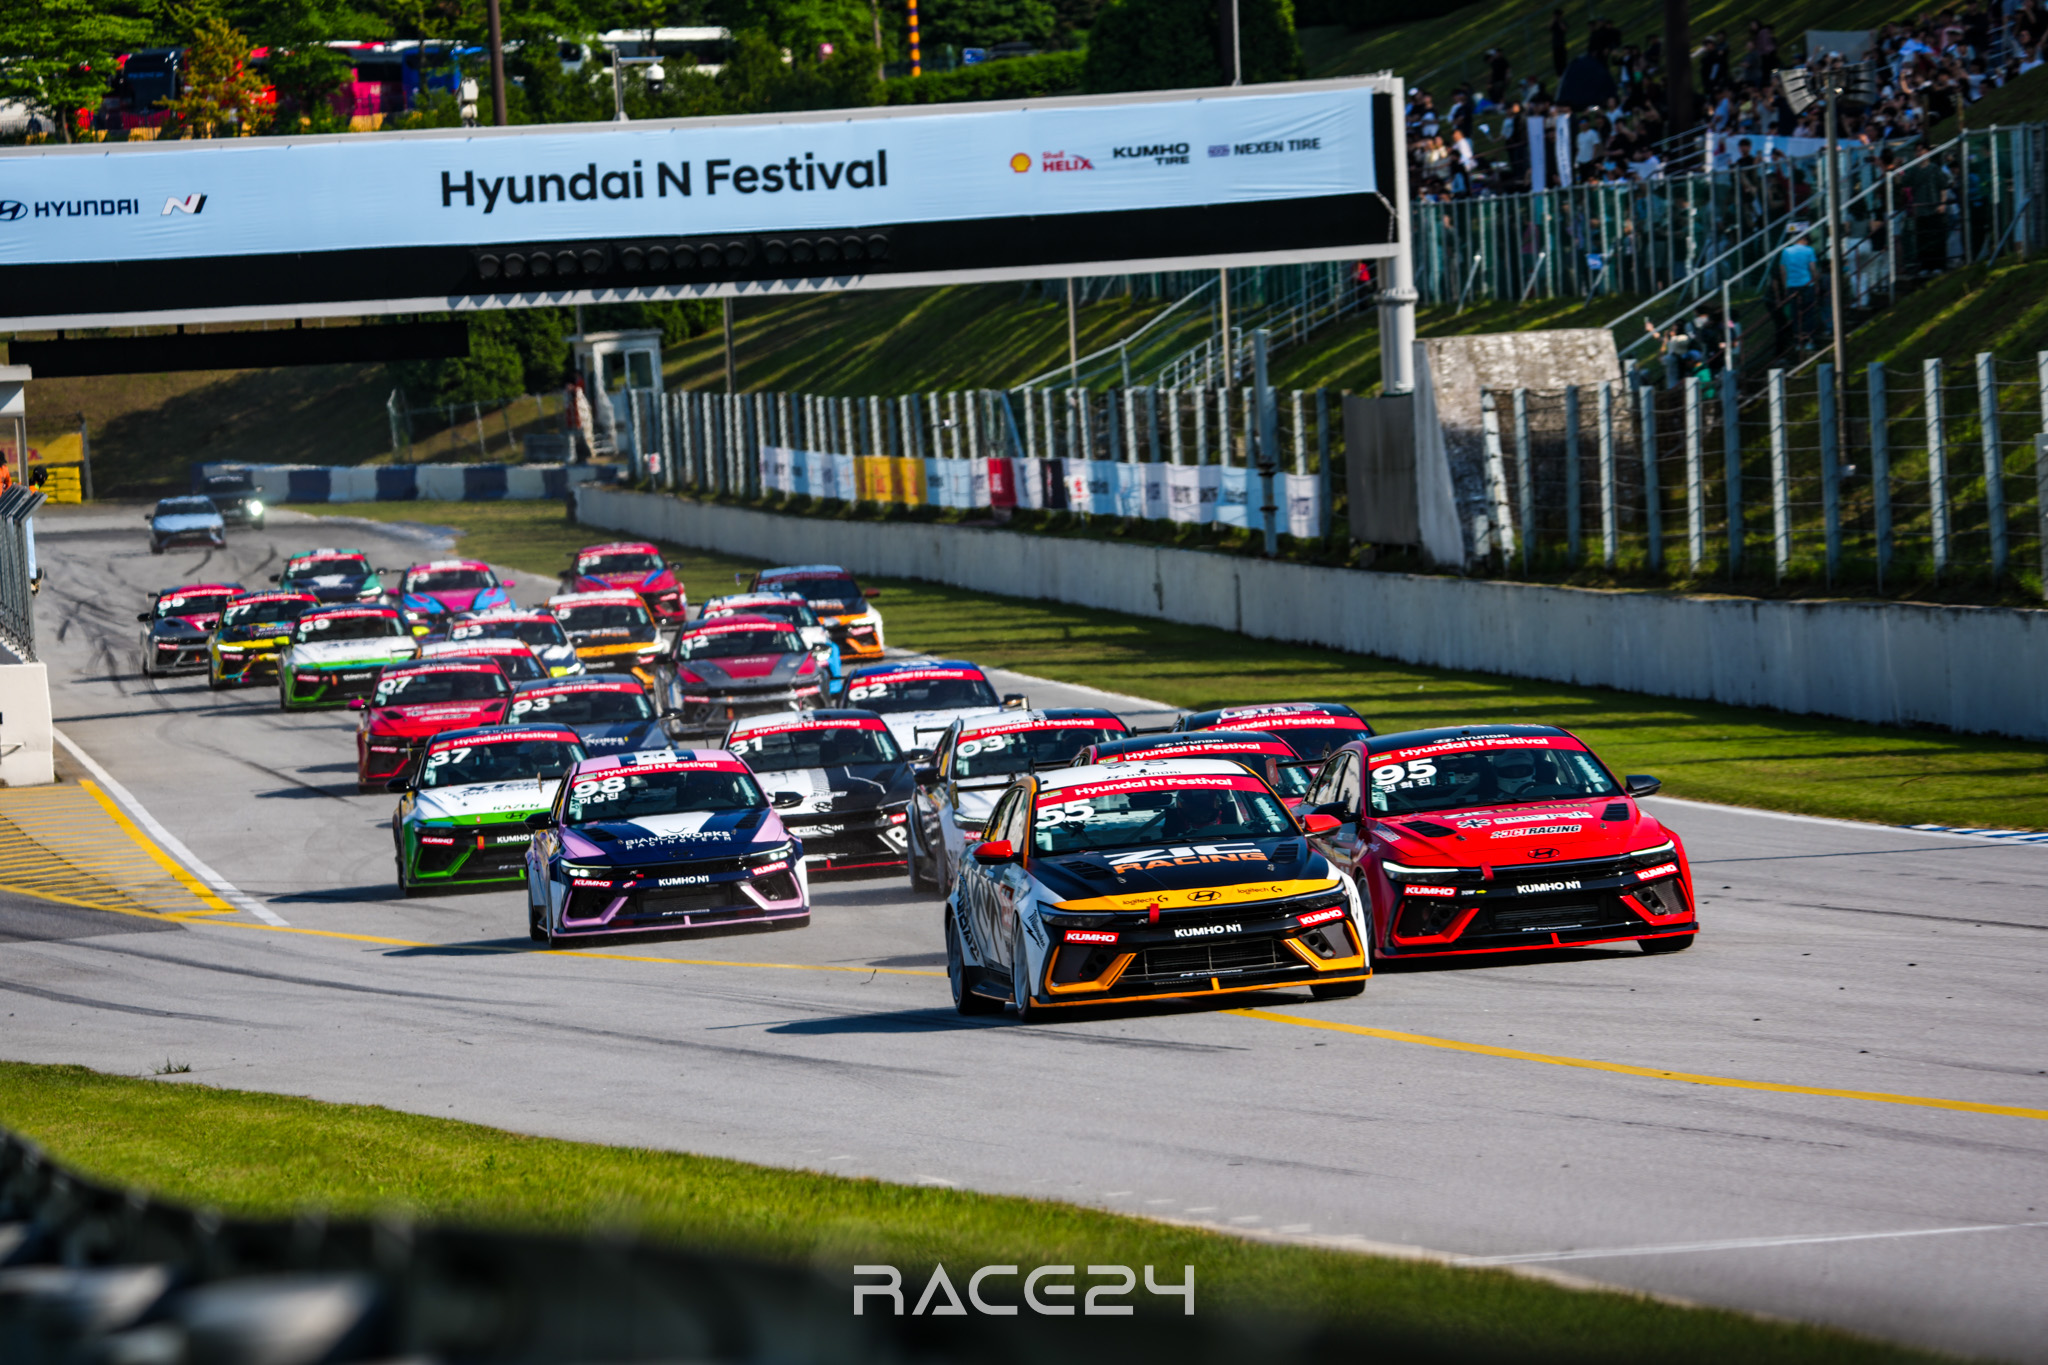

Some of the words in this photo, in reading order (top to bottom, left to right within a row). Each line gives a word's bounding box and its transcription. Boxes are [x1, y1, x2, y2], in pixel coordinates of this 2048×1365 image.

[1113, 142, 1190, 159] KUMHO
[1233, 141, 1284, 156] NEXEN
[1288, 137, 1322, 151] TIRE
[1042, 157, 1095, 172] HELIX
[1154, 156, 1190, 166] TIRE
[440, 160, 642, 214] Hyundai
[657, 160, 692, 198] N
[706, 149, 888, 195] Festival
[34, 199, 139, 217] HYUNDAI
[226, 604, 251, 617] 77
[848, 683, 888, 701] 62
[512, 697, 550, 716] 93
[753, 723, 803, 735] Hyundai
[815, 719, 860, 728] Festival
[980, 721, 1034, 735] Hyundai
[1046, 719, 1095, 727] Festival
[1214, 720, 1270, 732] Hyundai
[1284, 717, 1335, 725] Festival
[453, 734, 502, 746] Hyundai
[1175, 738, 1223, 746] HYUNDAI
[1456, 733, 1510, 742] HYUNDAI
[729, 737, 763, 756] 31
[956, 735, 1006, 757] 03
[1124, 745, 1191, 761] Hyundai
[1204, 742, 1261, 751] Festival
[1399, 740, 1468, 758] Hyundai
[1469, 739, 1485, 748] N
[1487, 736, 1550, 746] Festival
[429, 747, 472, 766] 37
[597, 764, 654, 778] Hyundai
[667, 761, 718, 769] Festival
[1371, 758, 1437, 786] 95
[573, 776, 627, 798] 98
[1074, 779, 1148, 796] Hyundai
[1150, 778, 1164, 786] N
[1165, 777, 1233, 786] Festival
[578, 792, 619, 805] 이상진
[1035, 798, 1095, 827] 55
[1494, 803, 1592, 813] RACING
[496, 834, 530, 844] KUMHO
[625, 831, 730, 846] BIANCOWORKS
[1103, 842, 1262, 866] ZIC
[754, 862, 787, 875] KUMHO
[1113, 852, 1268, 875] RACING
[1638, 864, 1677, 879] KUMHO
[574, 879, 611, 887] KUMHO
[658, 876, 696, 887] KUMHO
[697, 874, 710, 883] N1
[1516, 882, 1564, 894] KUMHO
[1566, 880, 1581, 890] N1
[1237, 886, 1270, 895] logitech
[1405, 887, 1454, 896] KUMHO
[1122, 896, 1155, 906] logitech
[1300, 909, 1343, 925] KUMHO
[1066, 932, 1116, 942] KUMHO
[1174, 925, 1224, 938] KUMHO
[1226, 923, 1242, 933] N1
